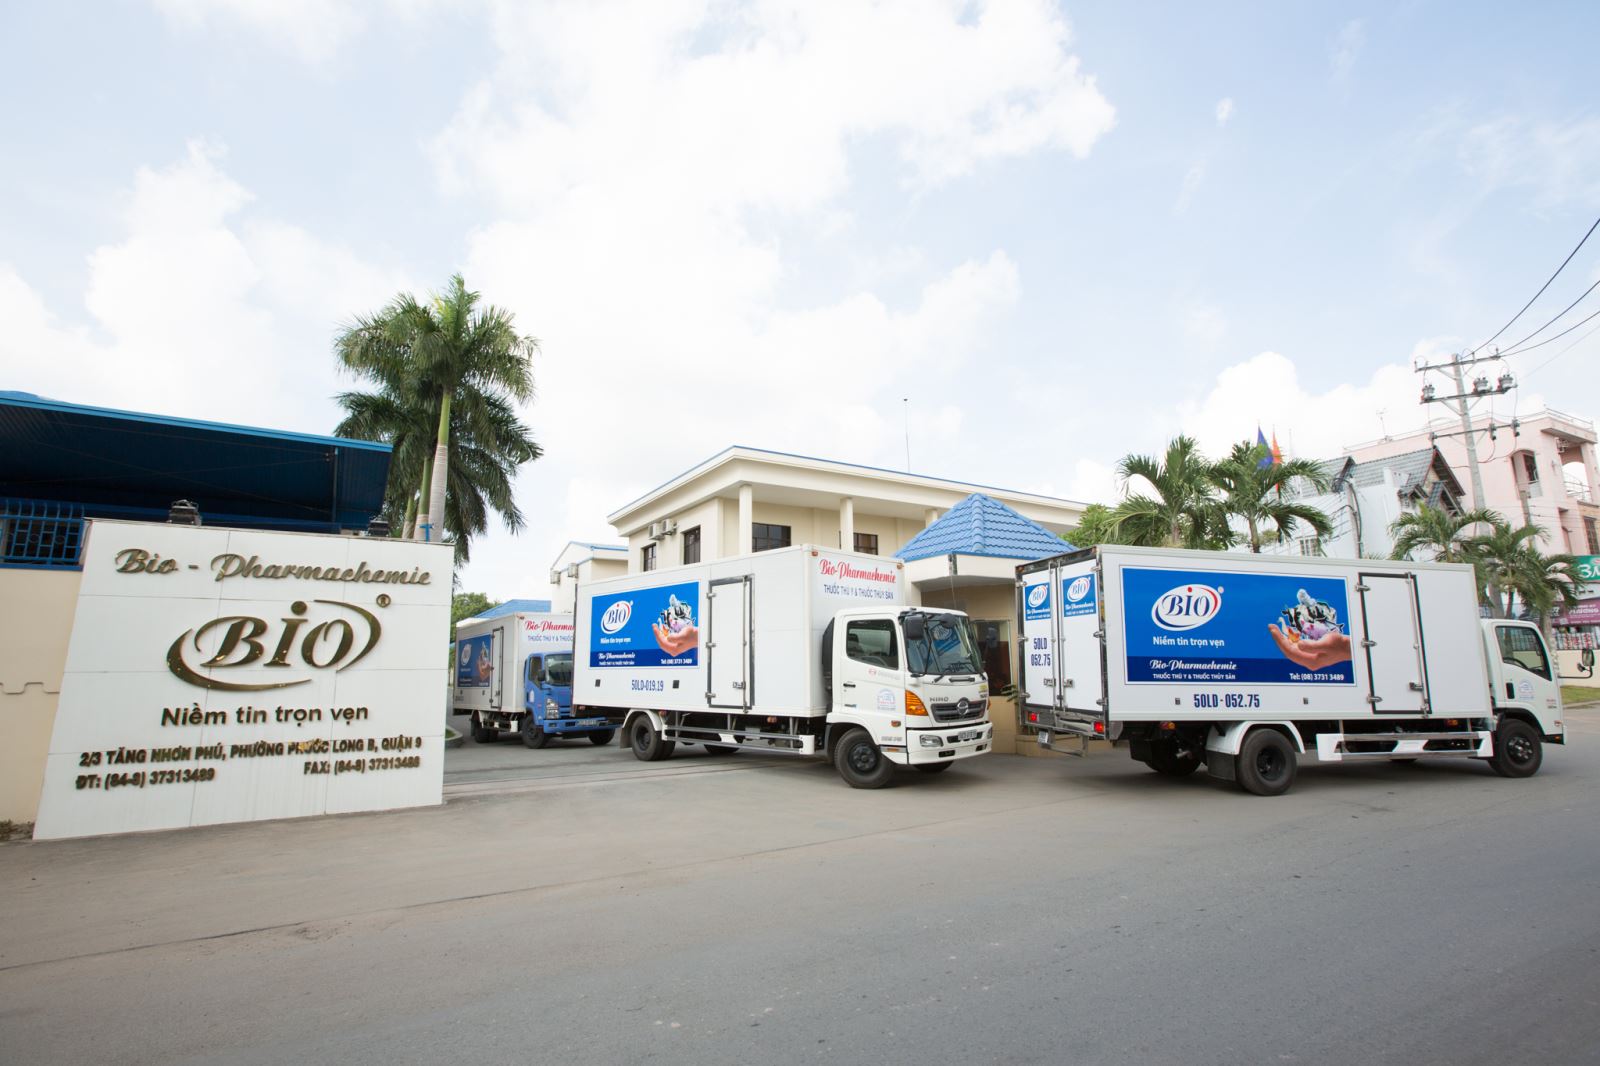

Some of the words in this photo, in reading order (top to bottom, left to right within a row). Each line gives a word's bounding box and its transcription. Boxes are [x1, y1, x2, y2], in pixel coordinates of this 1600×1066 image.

[114, 548, 178, 574] Bio
[210, 552, 432, 585] Pharmachemie
[1177, 637, 1189, 646] tin
[1190, 638, 1208, 648] trọn
[1209, 640, 1225, 648] vẹn
[1030, 653, 1051, 667] 052.75
[1149, 659, 1237, 671] Bio-Pharmachemie
[1314, 673, 1328, 681] 3731
[161, 702, 227, 727] Niềm
[235, 706, 267, 724] tin
[275, 706, 322, 727] trọn
[330, 706, 369, 725] vẹn
[79, 752, 101, 767] 2/3
[106, 746, 147, 764] TĂNG
[195, 742, 226, 761] PHÚ,
[230, 740, 284, 758] PHƯỜNG
[332, 738, 364, 753] LONG
[368, 738, 378, 753] B,
[381, 734, 413, 752] QUẬN
[415, 737, 422, 748] 9
[303, 761, 330, 775] FAX:
[105, 771, 146, 790] (84-8)
